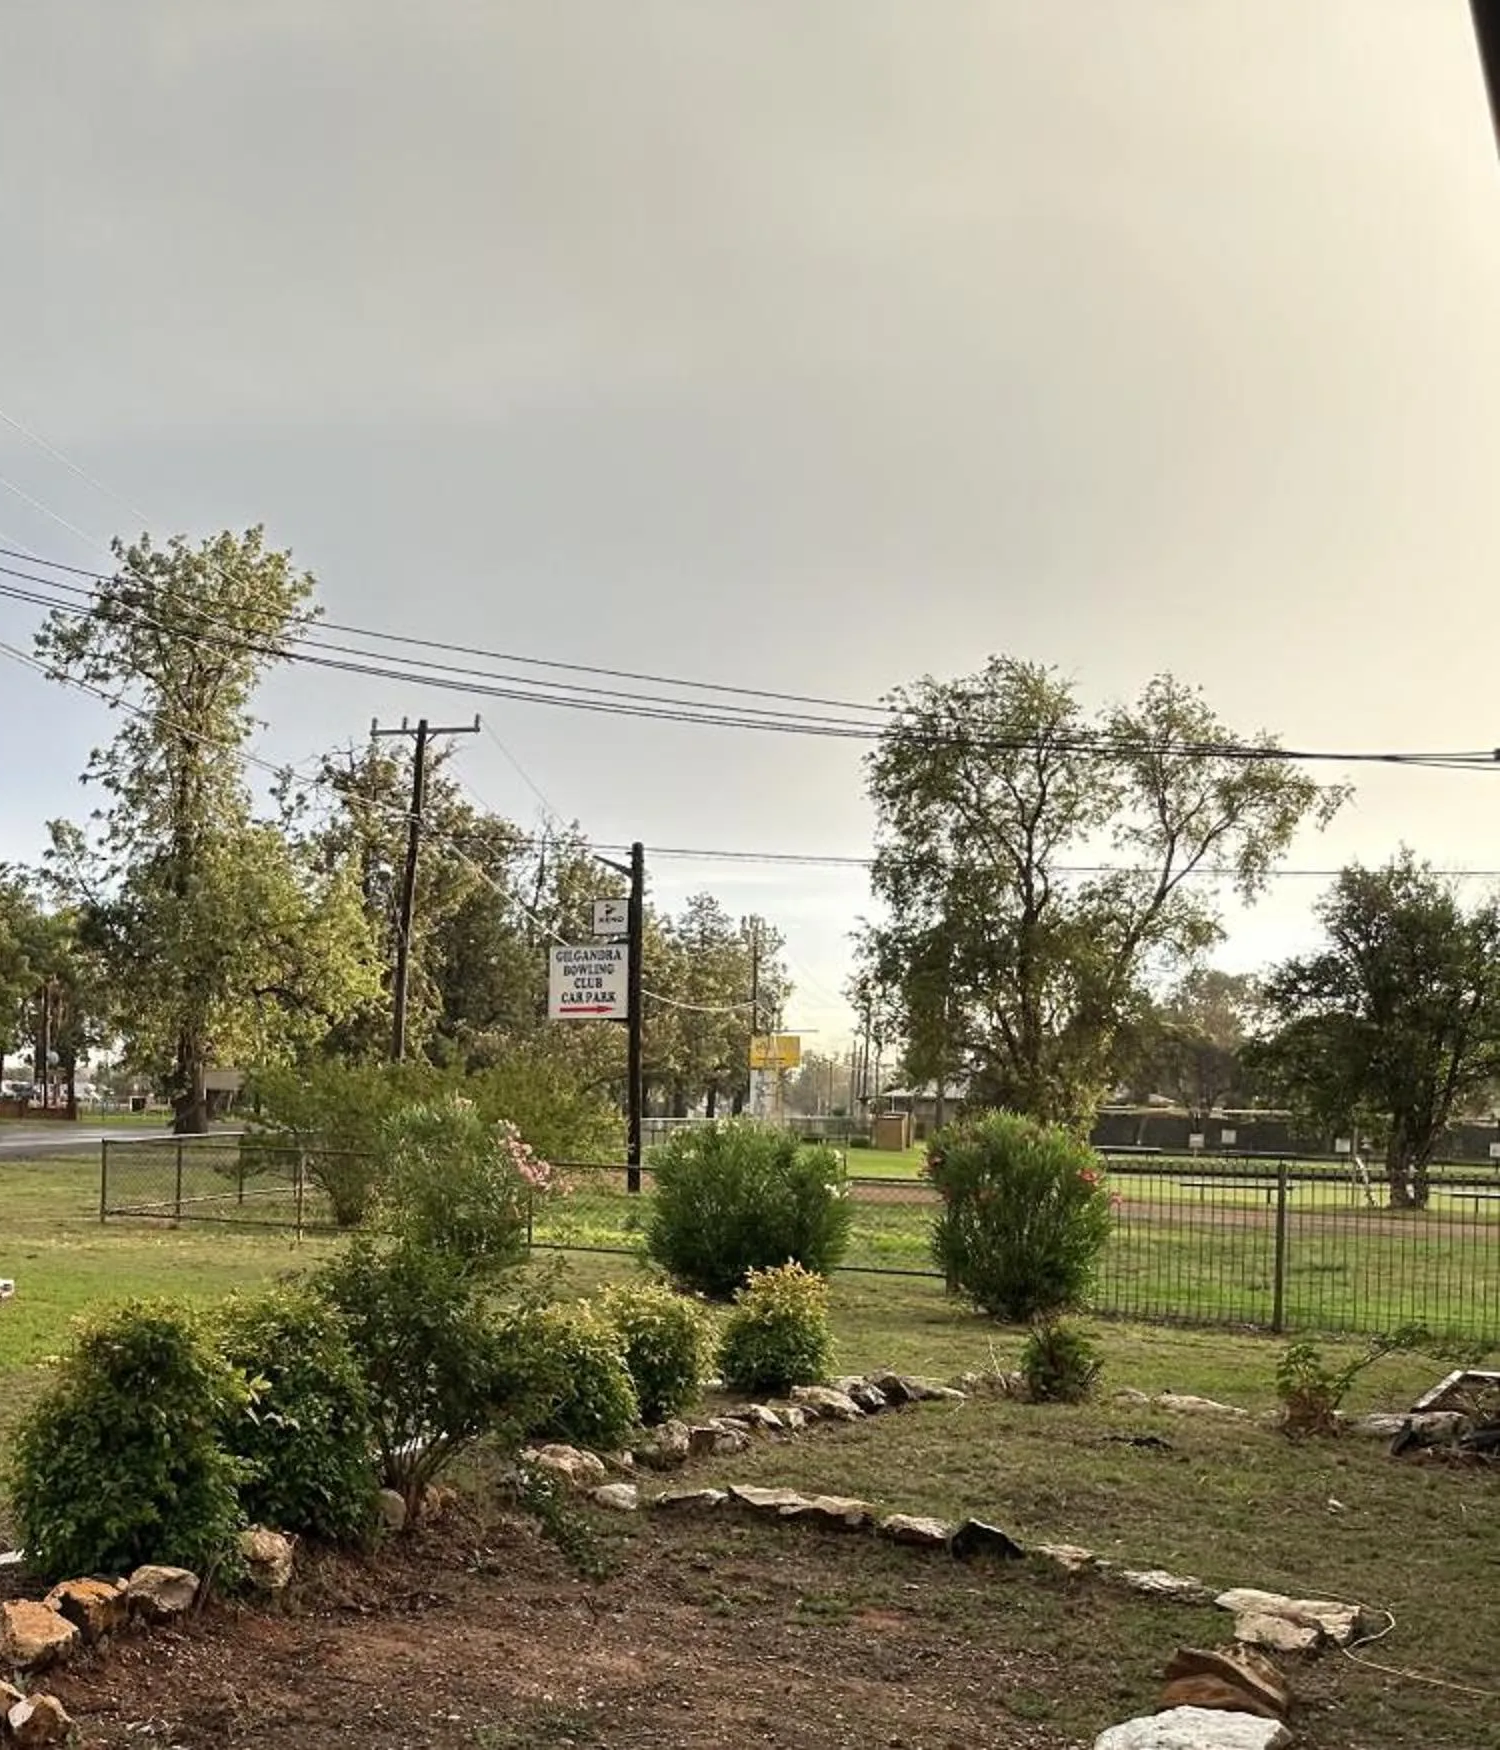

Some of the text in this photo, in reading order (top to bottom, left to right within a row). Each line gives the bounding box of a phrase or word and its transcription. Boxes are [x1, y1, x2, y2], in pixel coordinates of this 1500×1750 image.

[556, 950, 621, 962] GILGANDRA
[563, 963, 615, 976] BOWLING
[573, 977, 603, 989] CLUB
[561, 991, 617, 1004] CAR PARK
